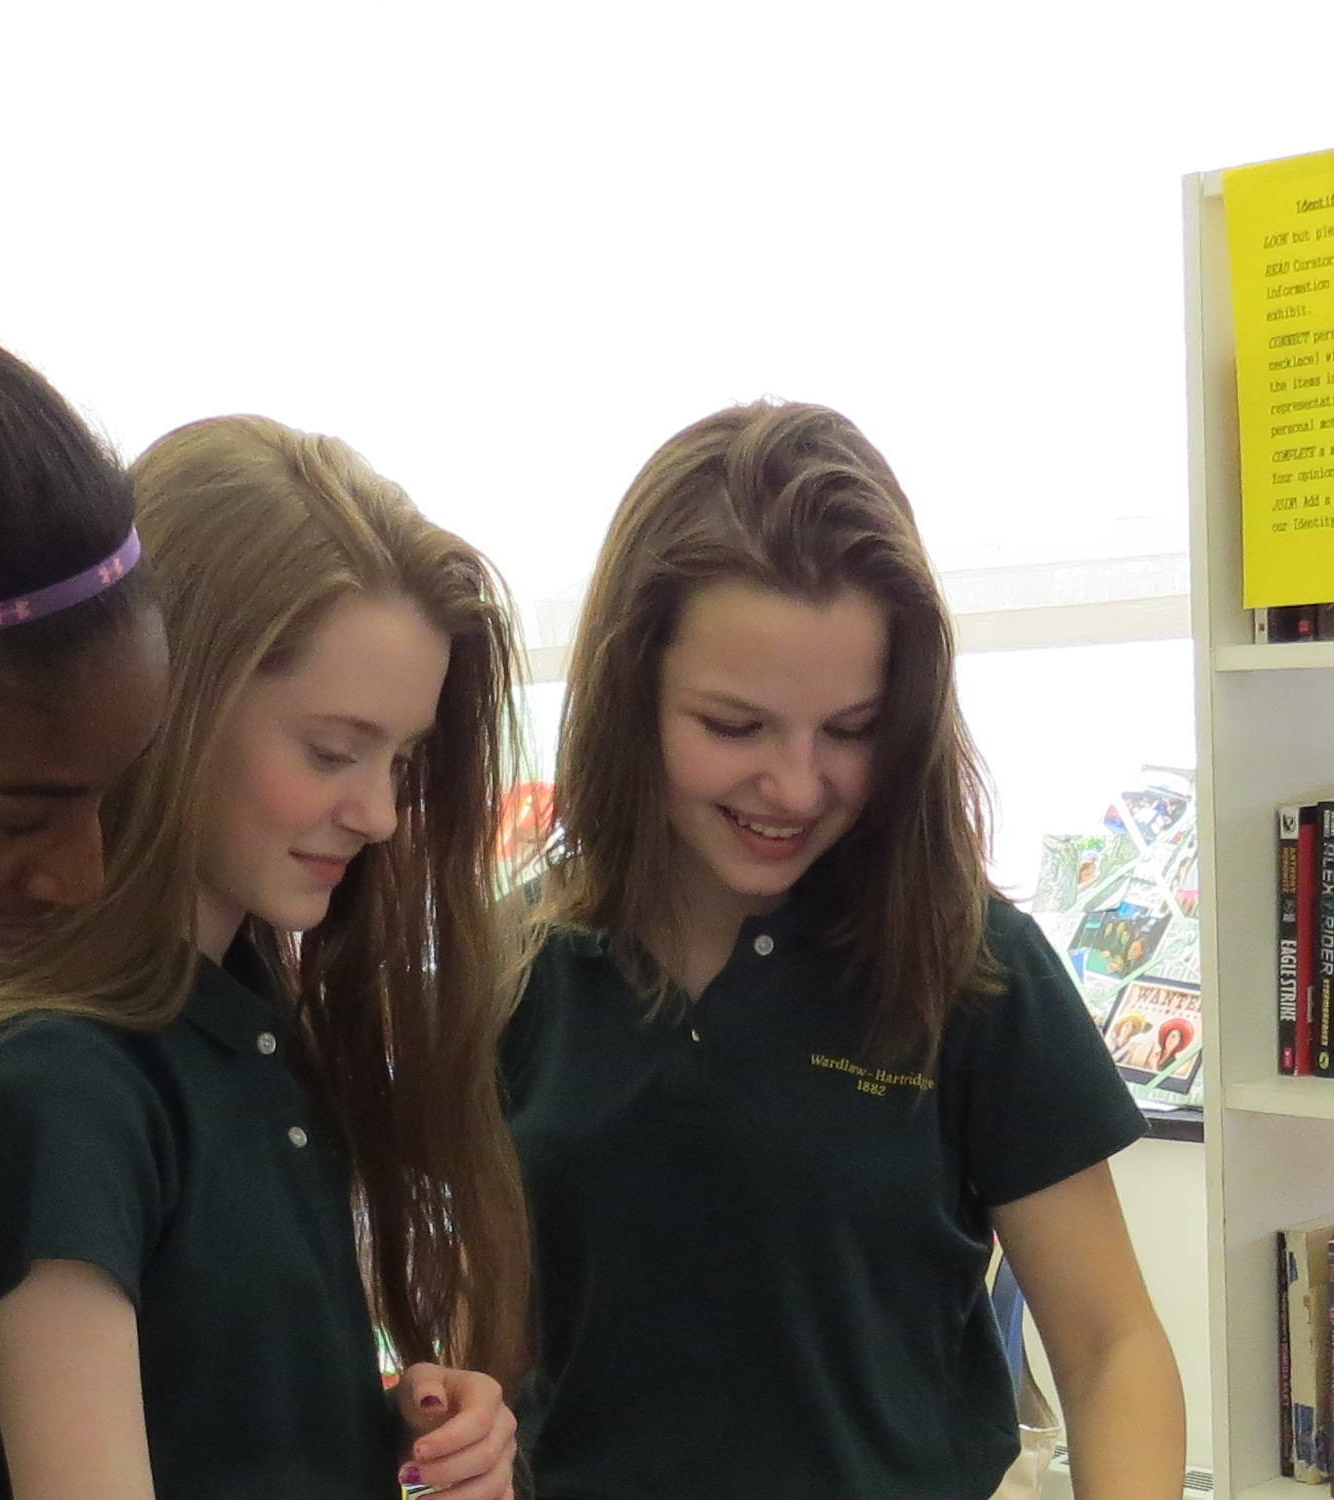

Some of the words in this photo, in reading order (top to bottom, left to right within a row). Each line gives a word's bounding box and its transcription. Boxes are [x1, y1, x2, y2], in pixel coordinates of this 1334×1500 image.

[1264, 232, 1288, 249] LOOK
[1292, 229, 1310, 244] but
[1266, 279, 1330, 300] information
[1266, 305, 1312, 323] exhibit.
[1268, 350, 1320, 371] necklace)
[1269, 380, 1287, 393] the
[1293, 375, 1320, 390] items
[1271, 420, 1314, 438] personal
[1272, 445, 1317, 464] COMPLETE
[1272, 470, 1293, 485] Your
[1303, 495, 1320, 508] Add
[1272, 521, 1288, 533] our
[1320, 913, 1334, 976] RIDER
[1280, 939, 1297, 976] EAGLE
[1137, 985, 1203, 1013] WANTE
[1280, 978, 1297, 1022] STRIKE
[810, 1053, 866, 1077] Wardlaw
[875, 1069, 935, 1090] Hartridge
[857, 1079, 886, 1097] 1882
